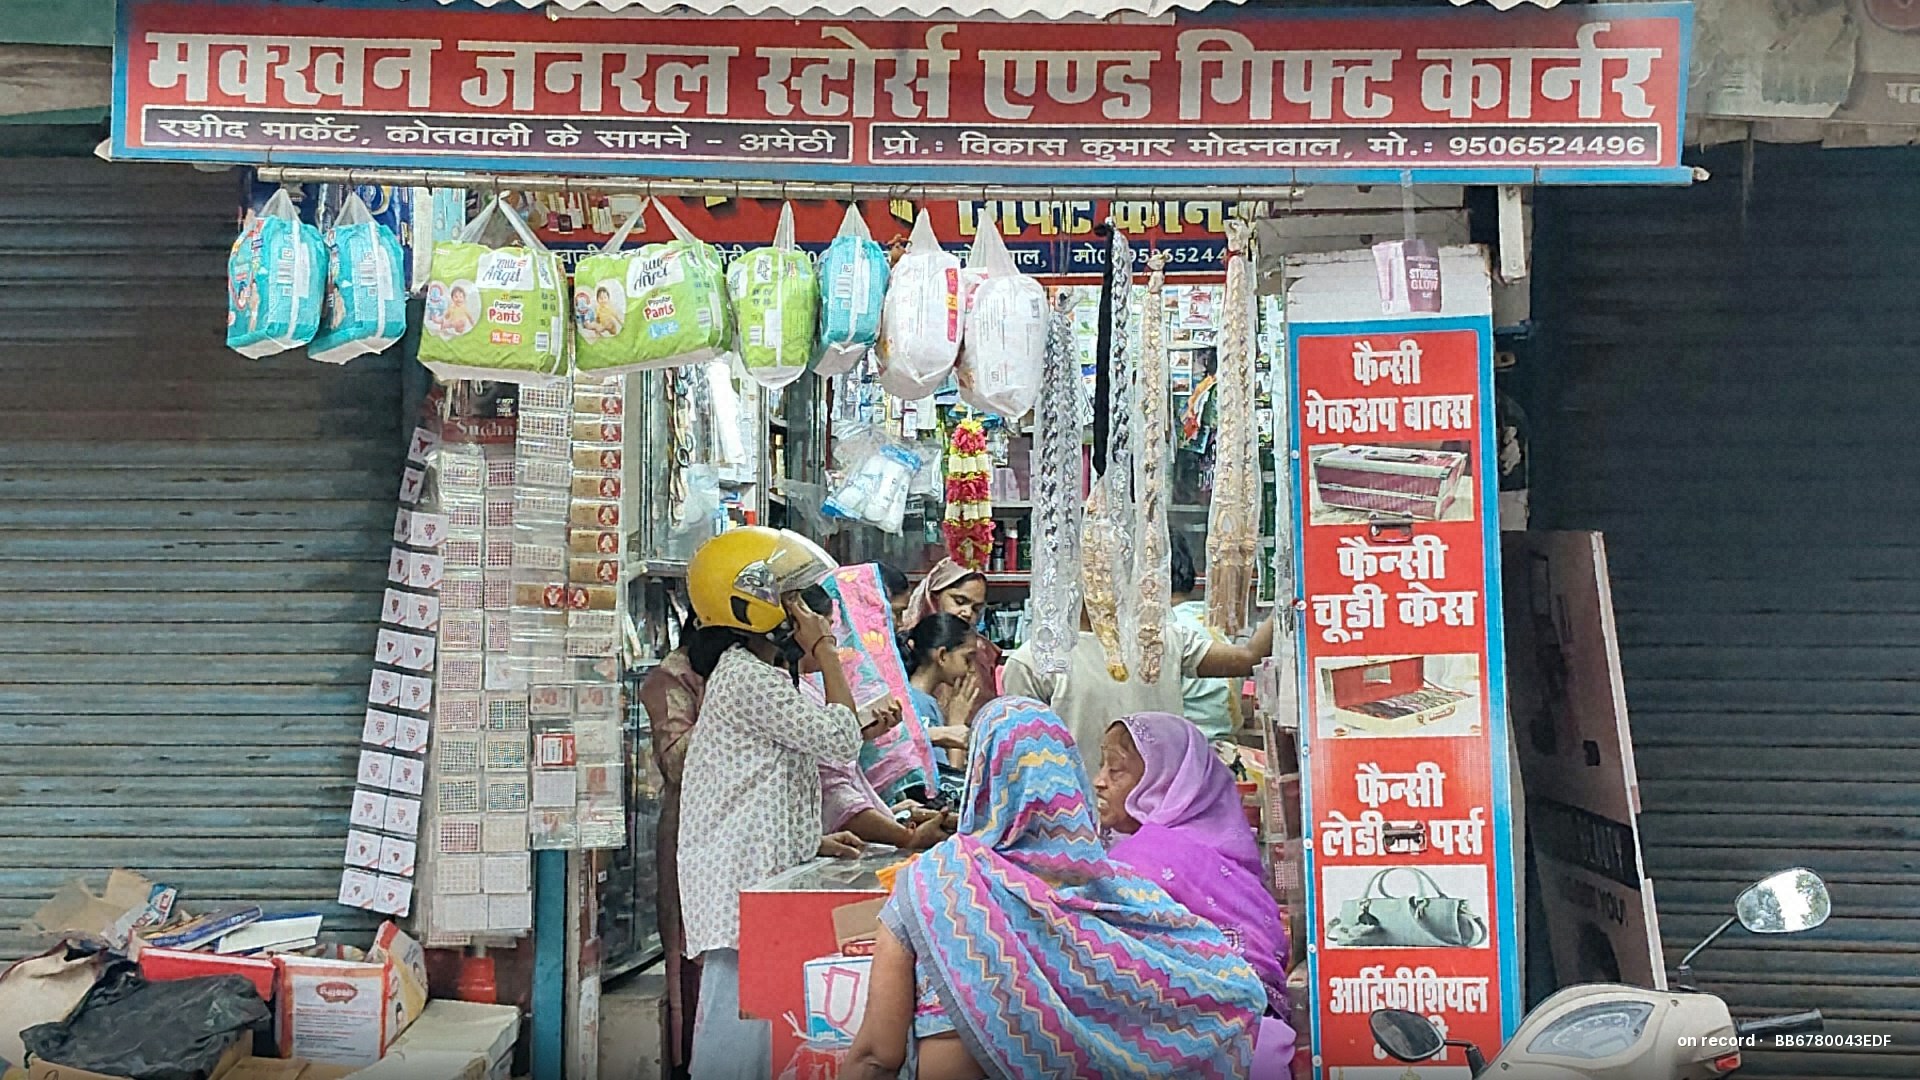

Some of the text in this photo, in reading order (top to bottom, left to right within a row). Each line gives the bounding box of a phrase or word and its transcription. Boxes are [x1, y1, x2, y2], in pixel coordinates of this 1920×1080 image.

[145, 22, 1662, 120] मक्खन जनरल स्टोर्स एण्ड गिफ्ट कार्नर
[158, 114, 248, 138] रशीद
[261, 117, 369, 144] मार्केट,
[385, 120, 533, 147] कोतवाली
[546, 123, 582, 148] के
[594, 125, 690, 149] सामने
[739, 128, 836, 153] अमेठी
[958, 131, 1068, 156] विकास
[1081, 138, 1175, 163] कुमार
[1450, 136, 1645, 155] 9506524496
[1410, 279, 1438, 291] GLOW
[488, 308, 522, 323] Pants
[644, 303, 675, 320] Pants
[1351, 339, 1422, 386] फैन्सी
[1305, 389, 1474, 434] मेकअप बाक्स
[1337, 534, 1448, 582] फैन्सी
[1311, 582, 1478, 644] चूड़ी केस
[1355, 761, 1446, 809] फैन्सी
[1429, 808, 1486, 856] पर्स
[1329, 965, 1489, 1014] आर्टिफीशियल
